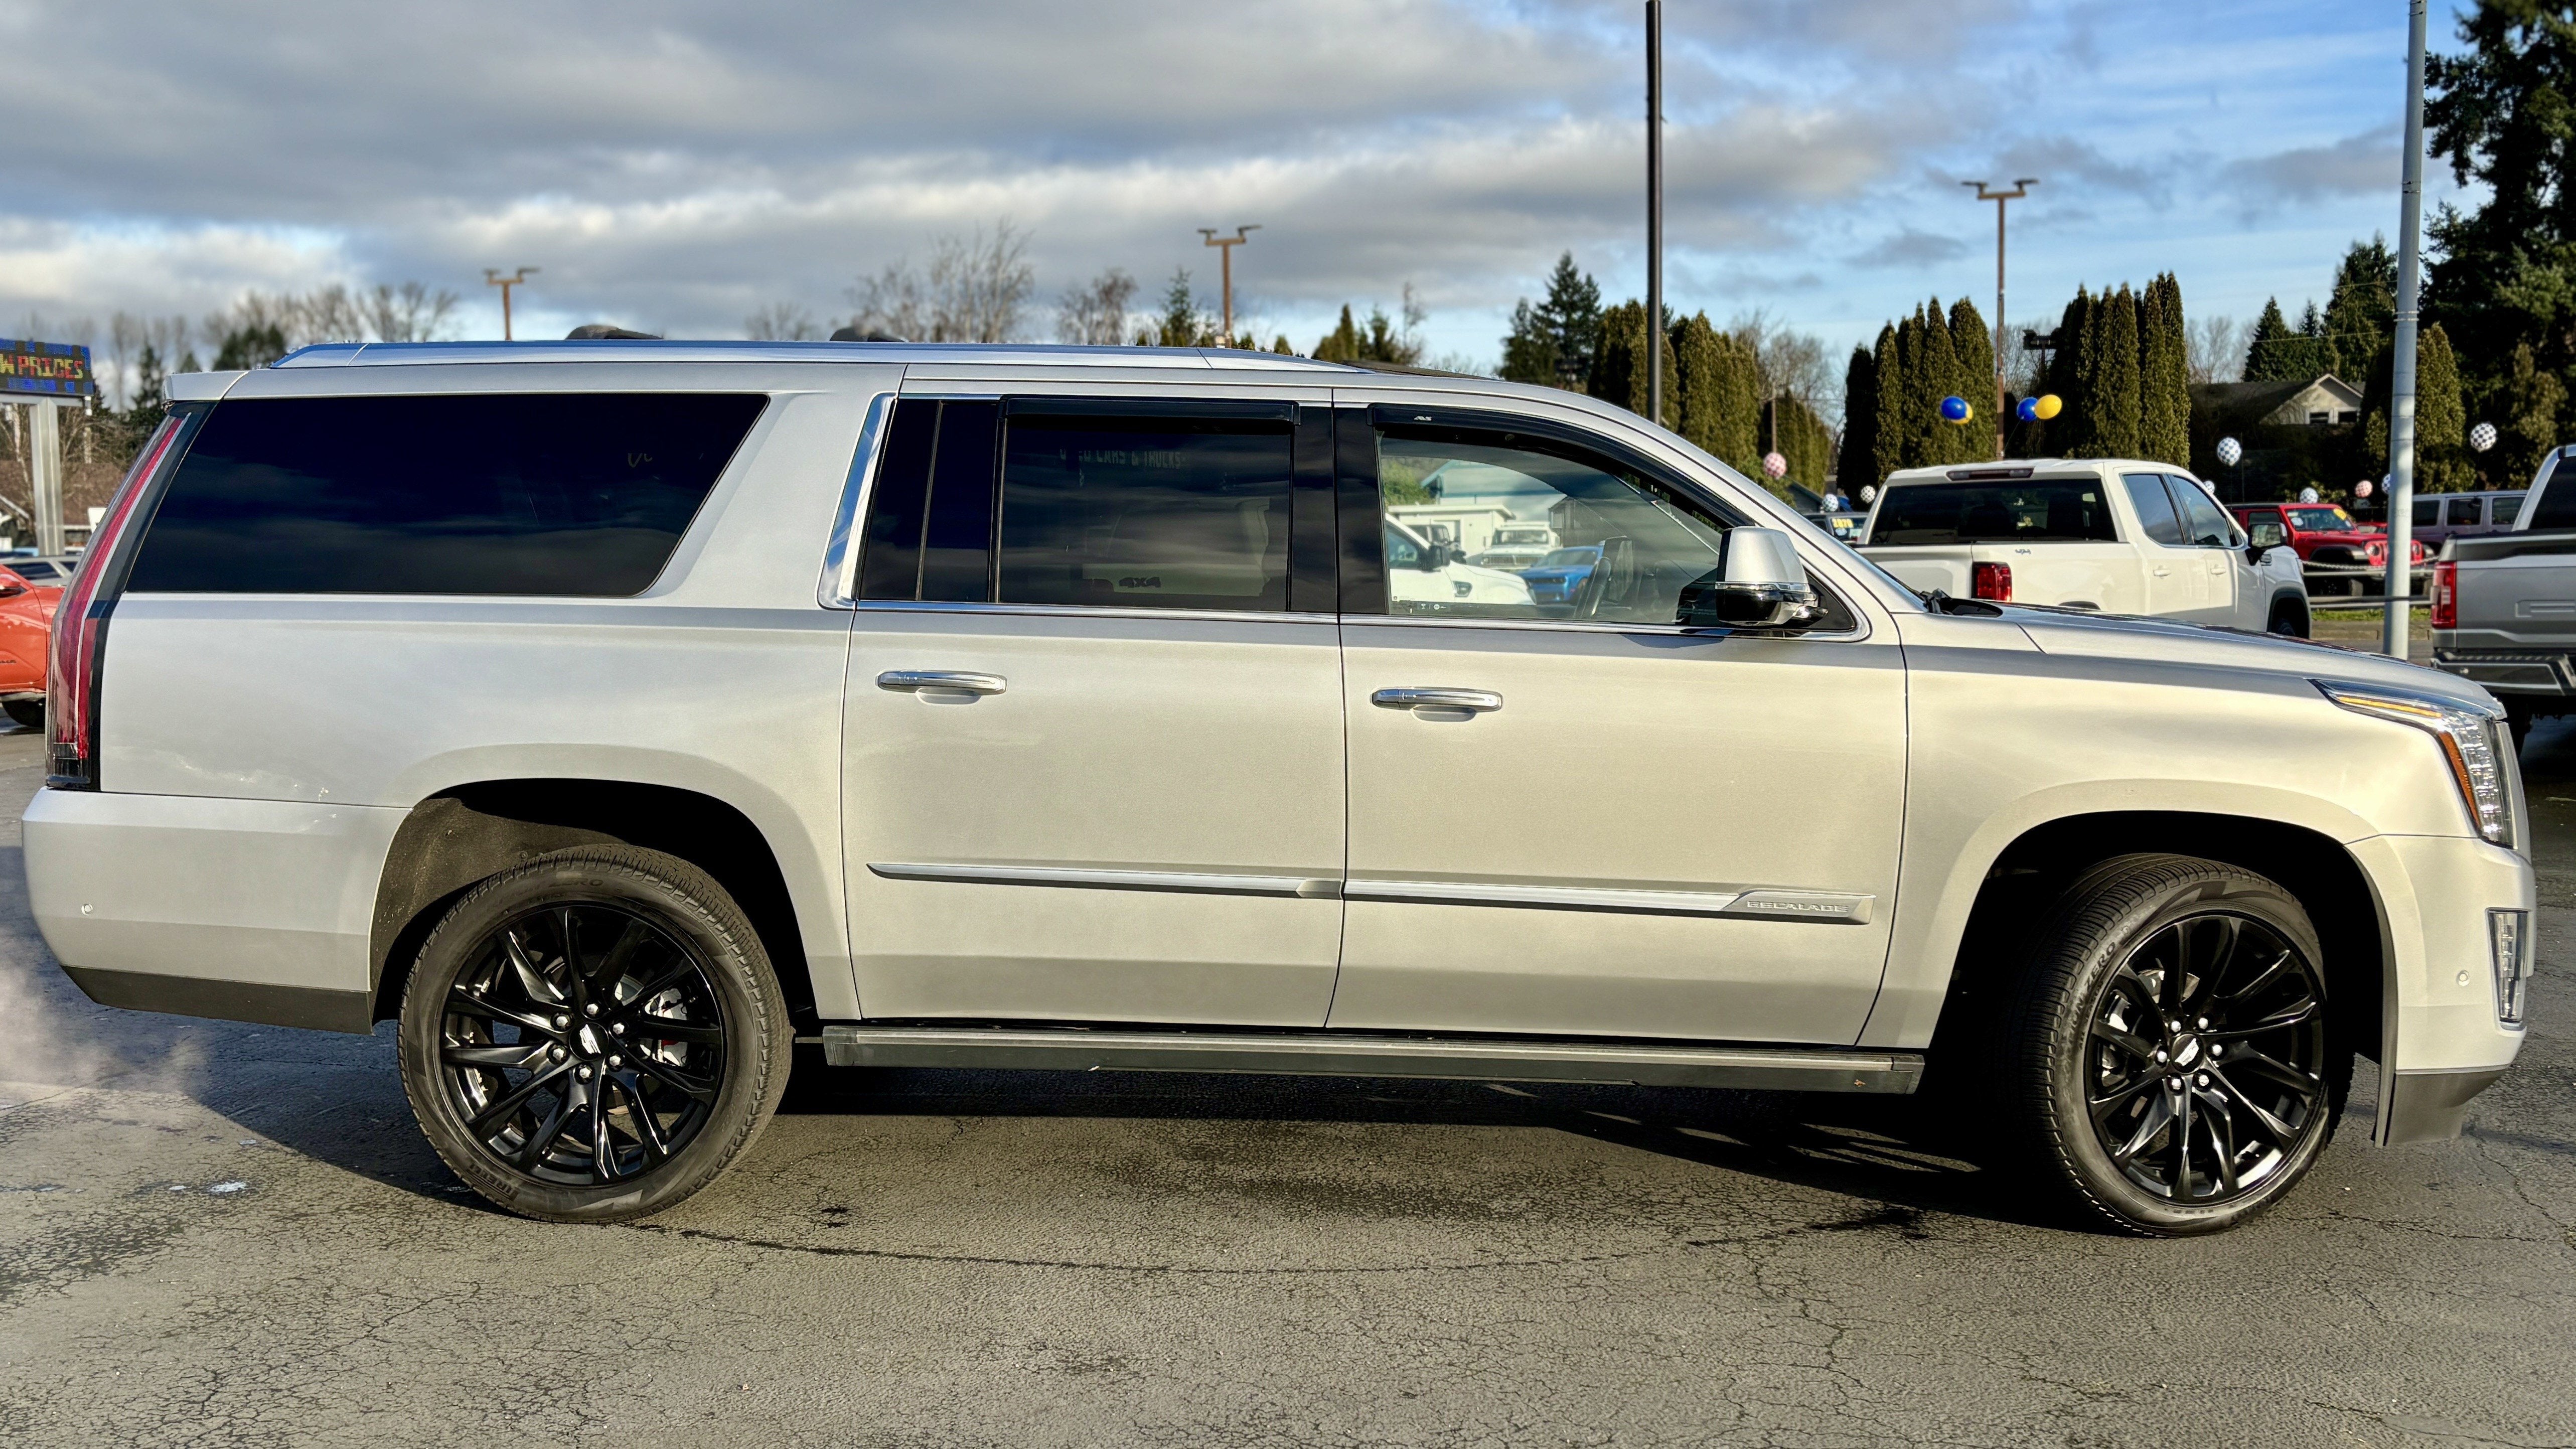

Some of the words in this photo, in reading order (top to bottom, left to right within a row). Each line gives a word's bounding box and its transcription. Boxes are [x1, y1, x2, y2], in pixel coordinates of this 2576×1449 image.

[17, 356, 83, 379] PRICES
[1747, 900, 1849, 913] ESCALADE
[2084, 942, 2115, 992] ZERO
